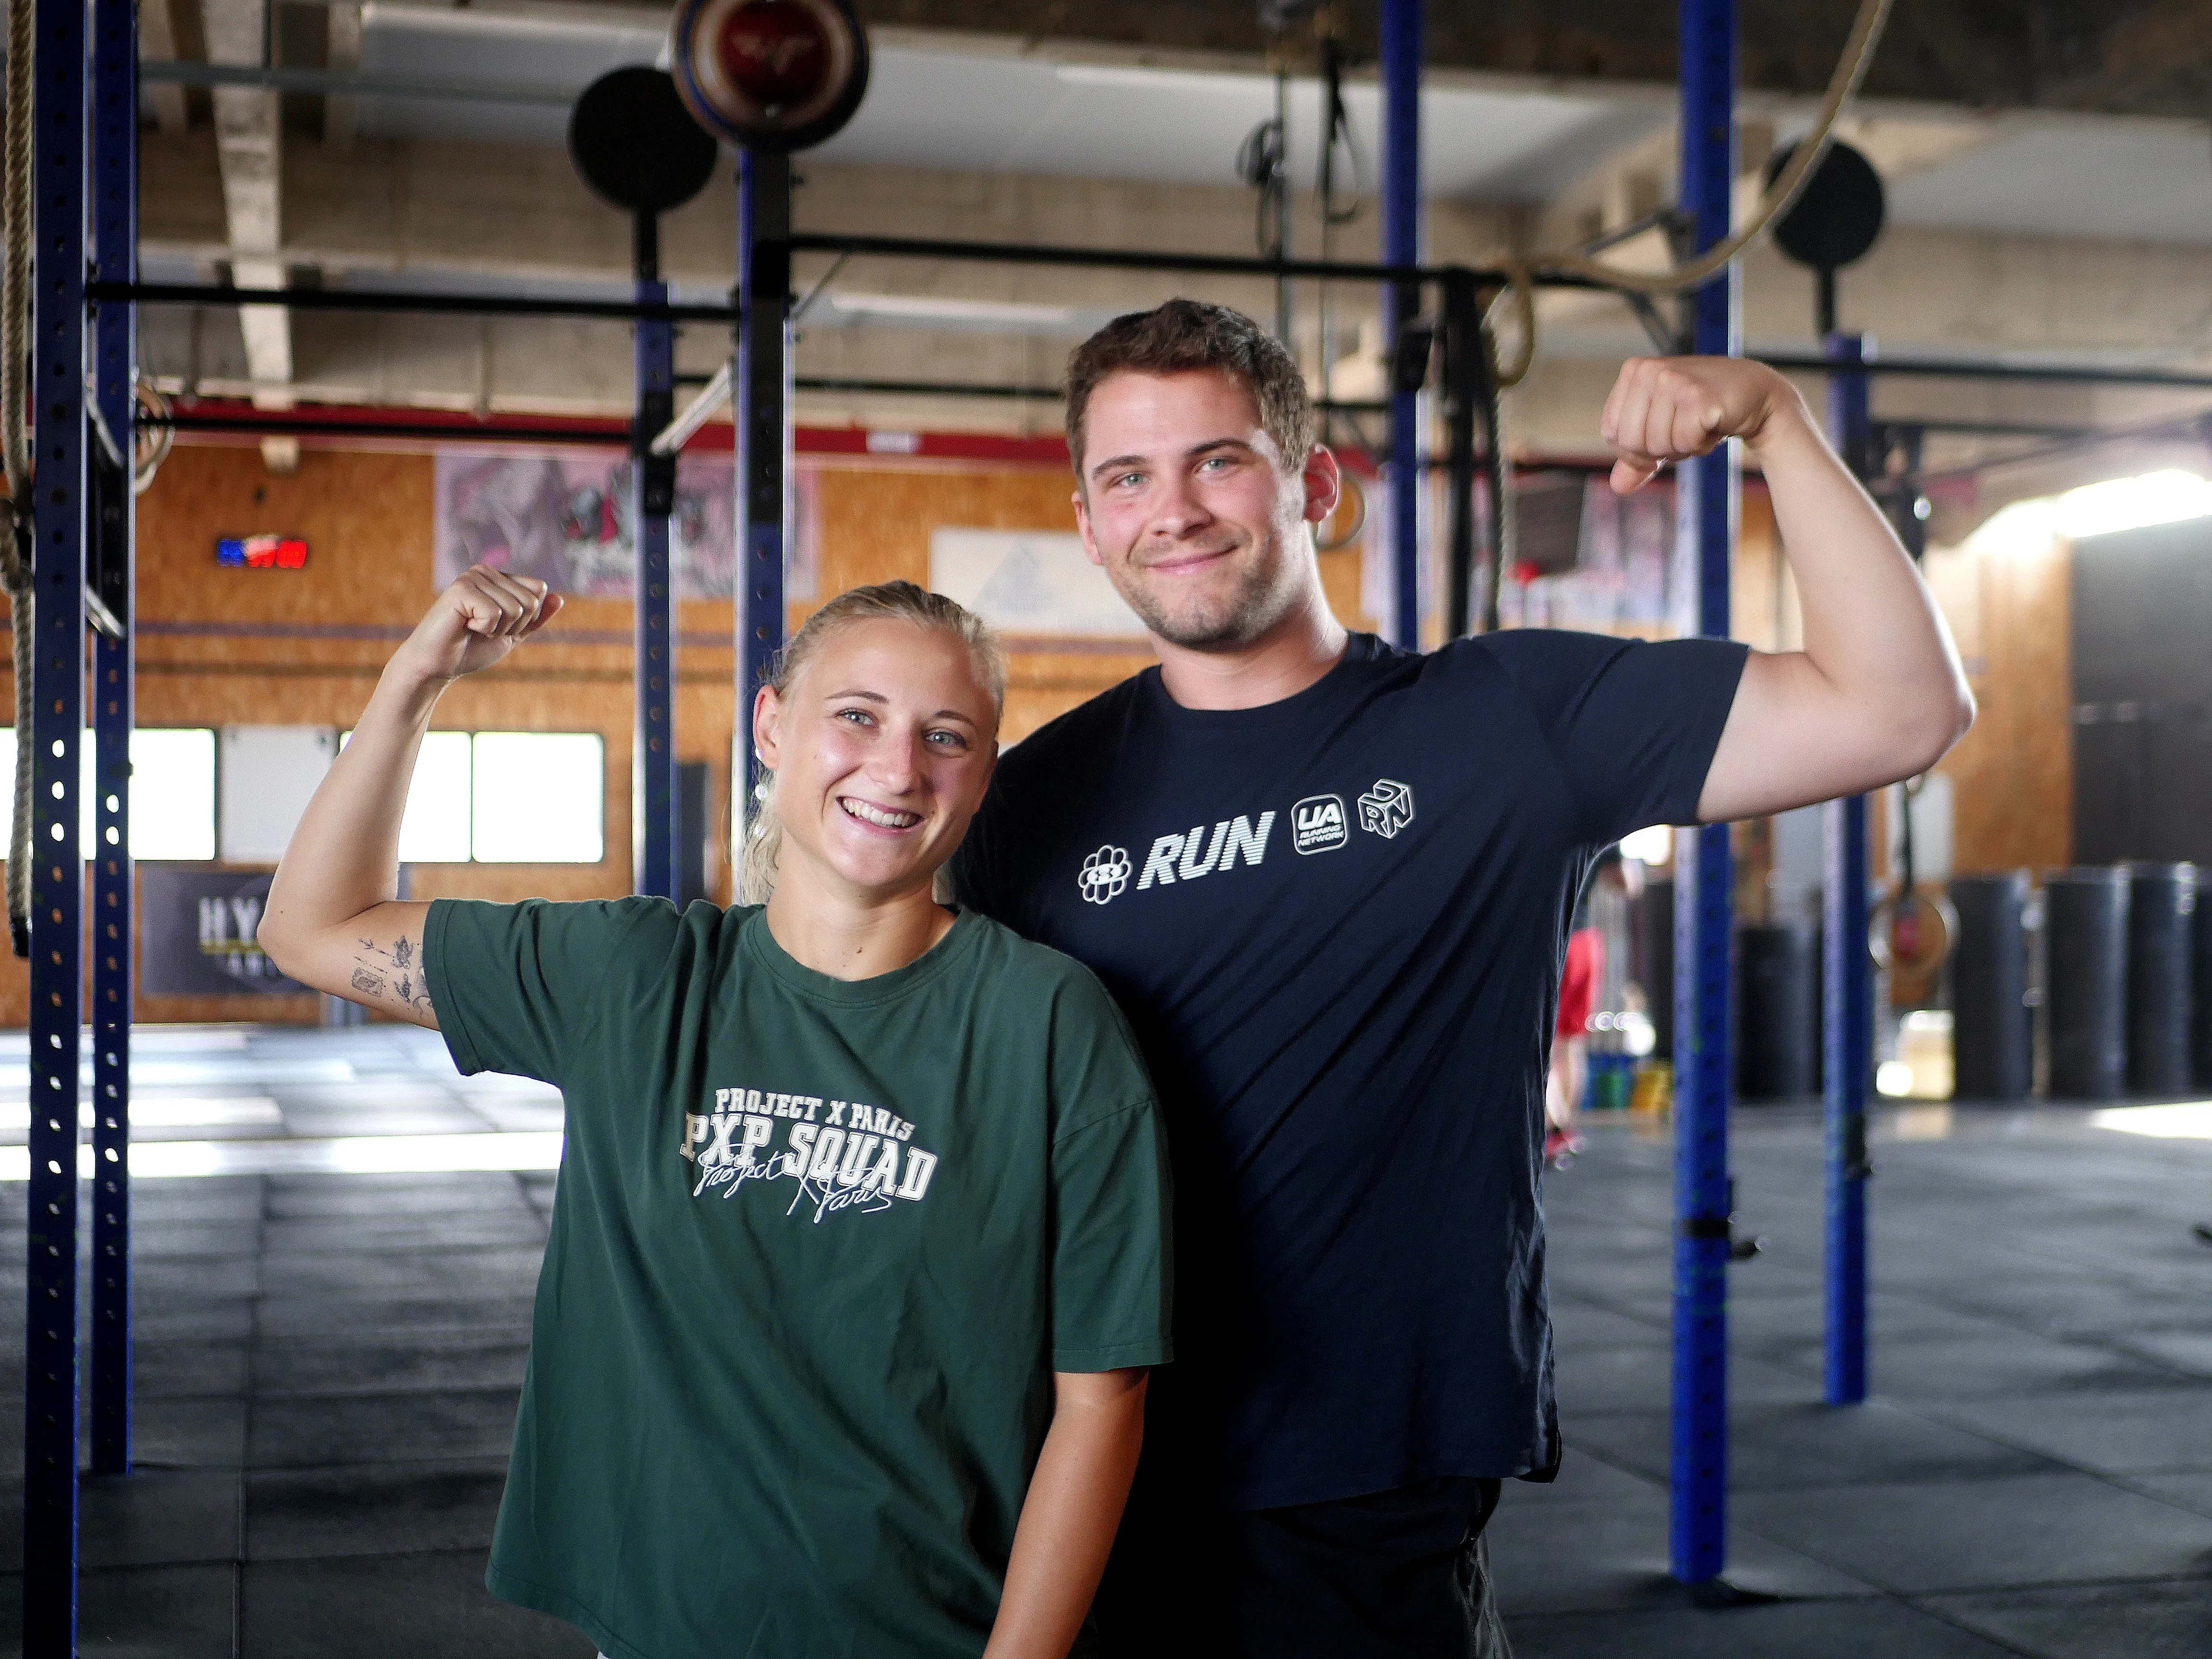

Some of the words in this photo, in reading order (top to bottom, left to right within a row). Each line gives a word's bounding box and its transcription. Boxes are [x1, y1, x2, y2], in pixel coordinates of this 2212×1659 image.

[1298, 803, 1342, 830] UA
[1299, 824, 1341, 839] RUNNING
[1136, 810, 1277, 890] RUN
[1298, 830, 1344, 846] NETWORK
[714, 1088, 823, 1120] PROJECT
[824, 1100, 847, 1125] X
[849, 1103, 915, 1141] PARIS
[680, 1111, 773, 1166] PXP
[781, 1121, 938, 1201] SQUAD
